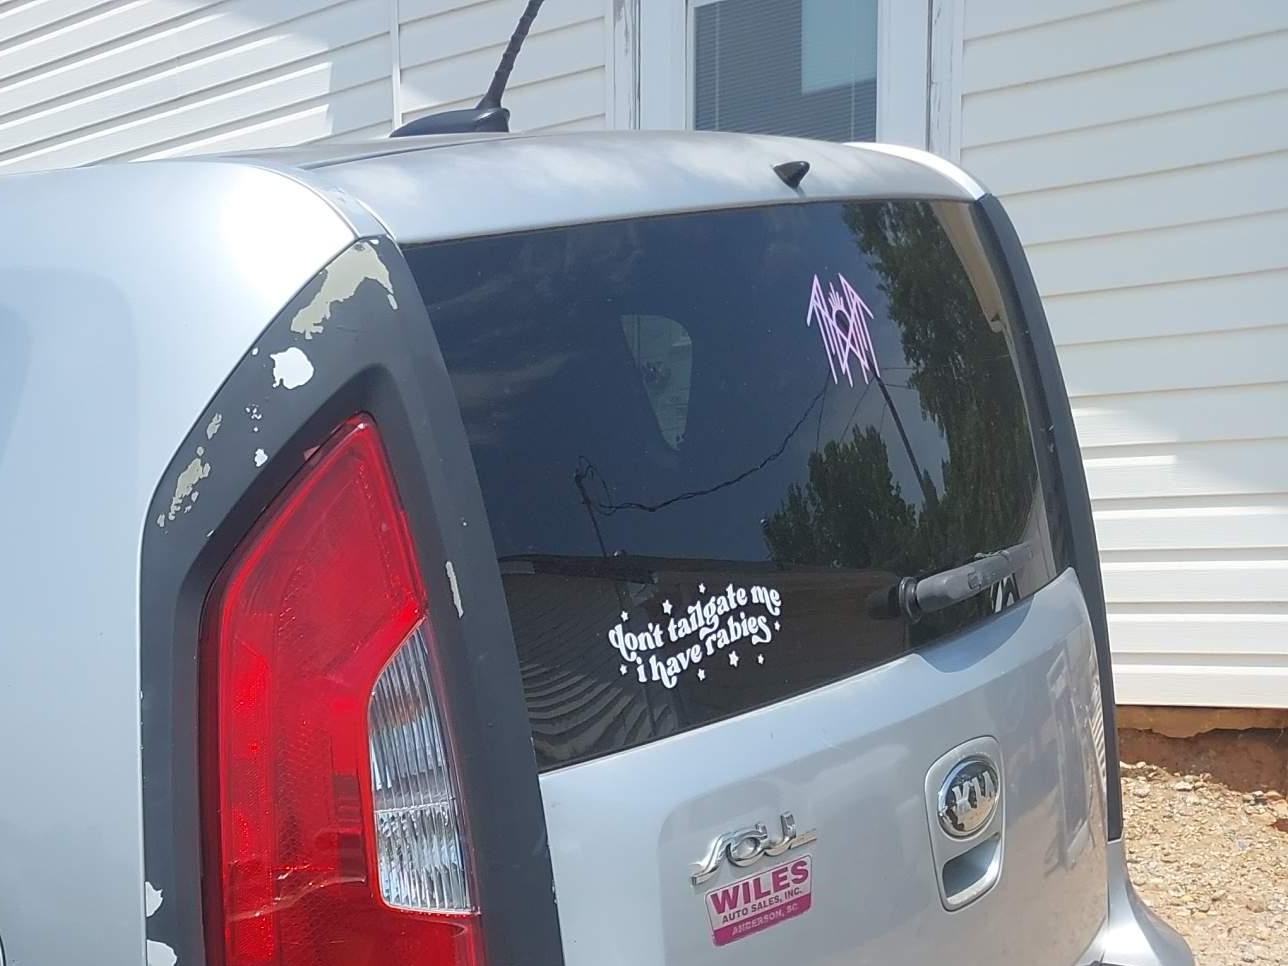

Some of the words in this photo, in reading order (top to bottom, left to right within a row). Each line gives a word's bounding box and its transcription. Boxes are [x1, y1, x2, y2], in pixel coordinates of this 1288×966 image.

[608, 622, 665, 662] don't
[667, 583, 748, 642] tailgate
[750, 585, 782, 616] me
[636, 656, 648, 683] i
[648, 643, 703, 689] have
[705, 611, 772, 656] rabies
[710, 860, 809, 915] WILES
[722, 906, 749, 925] AUTO
[751, 892, 783, 914] SALES,
[784, 886, 803, 900] INC.
